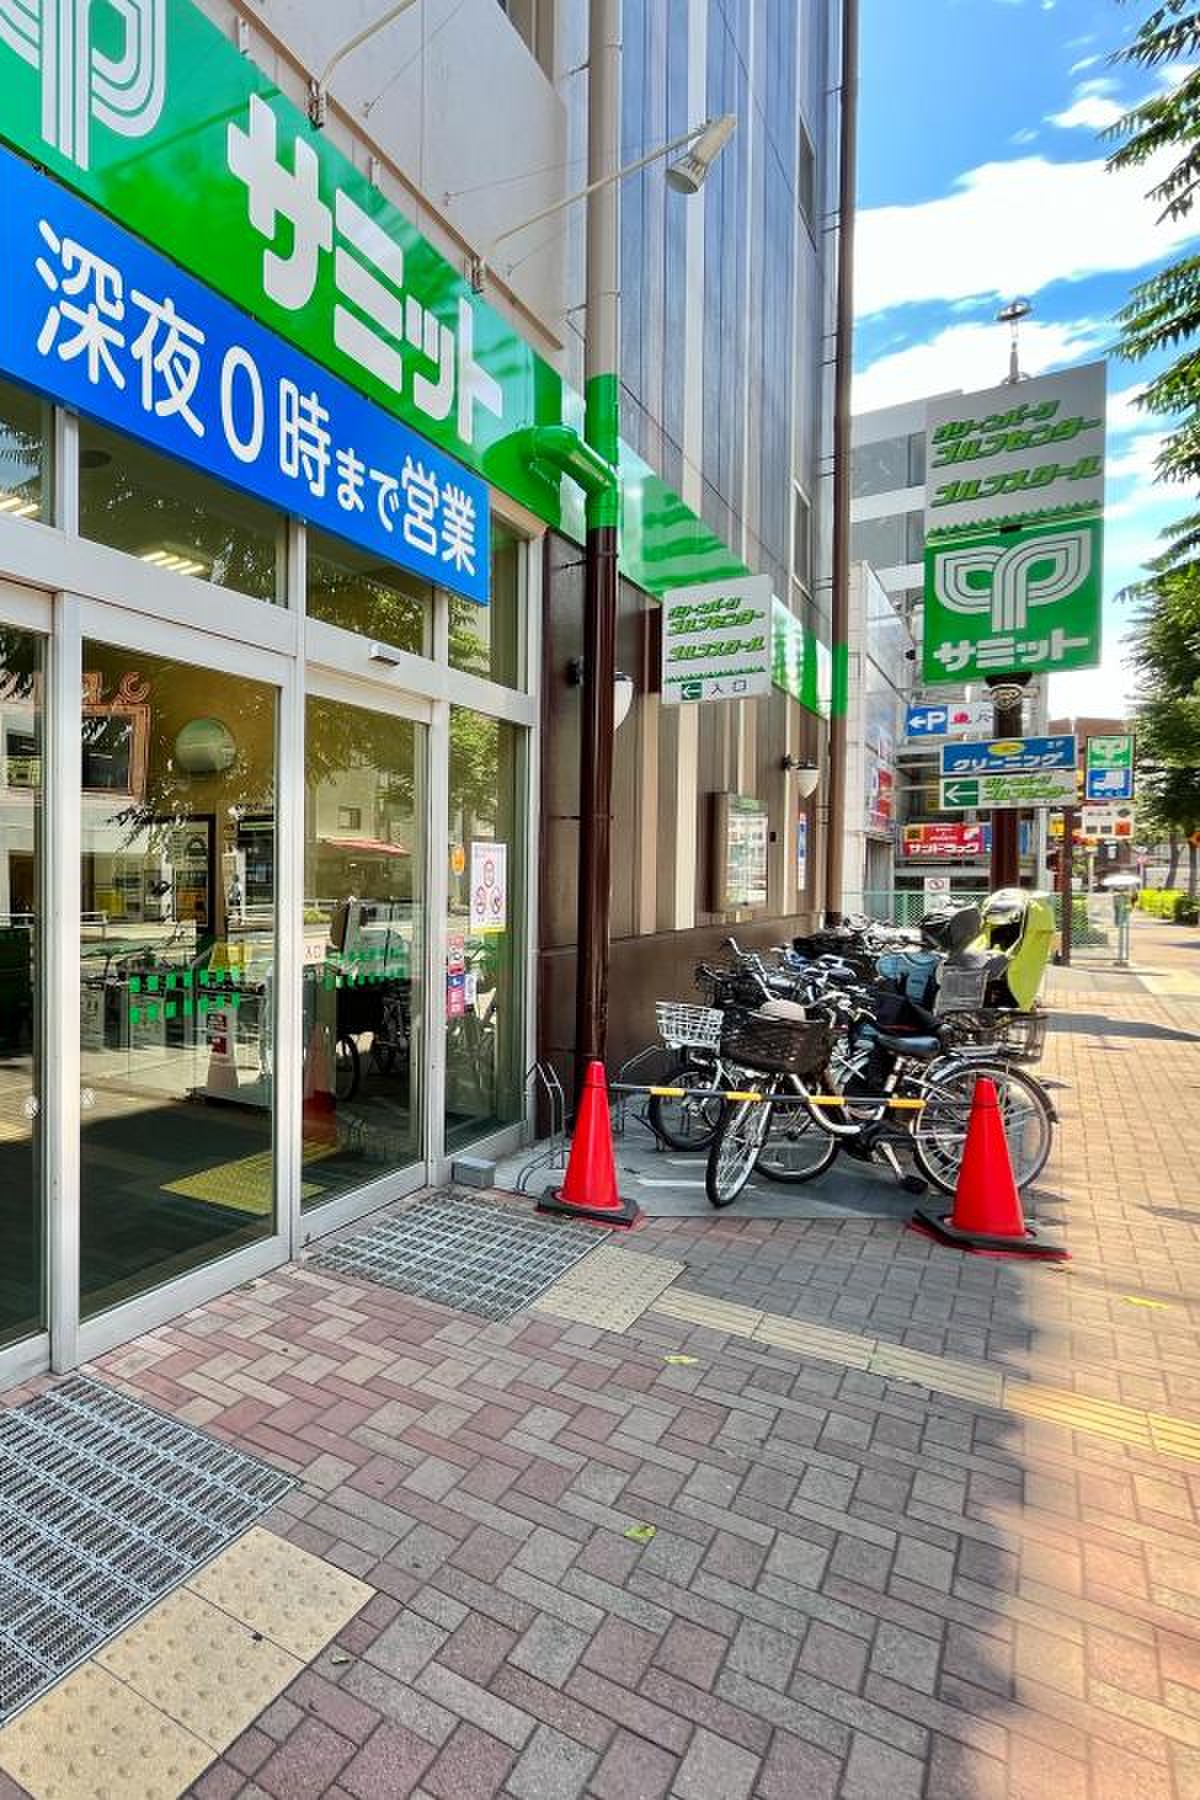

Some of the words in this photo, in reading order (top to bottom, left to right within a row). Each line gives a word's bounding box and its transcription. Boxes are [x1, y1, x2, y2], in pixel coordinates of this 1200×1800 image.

[227, 93, 503, 445] サミット
[931, 415, 1102, 468] ゴルフセンター
[930, 455, 1102, 508] ゴルフスクール
[933, 628, 1088, 672] サミット
[711, 680, 747, 695] 入口
[927, 711, 946, 731] P
[952, 750, 1065, 771] クリーニング
